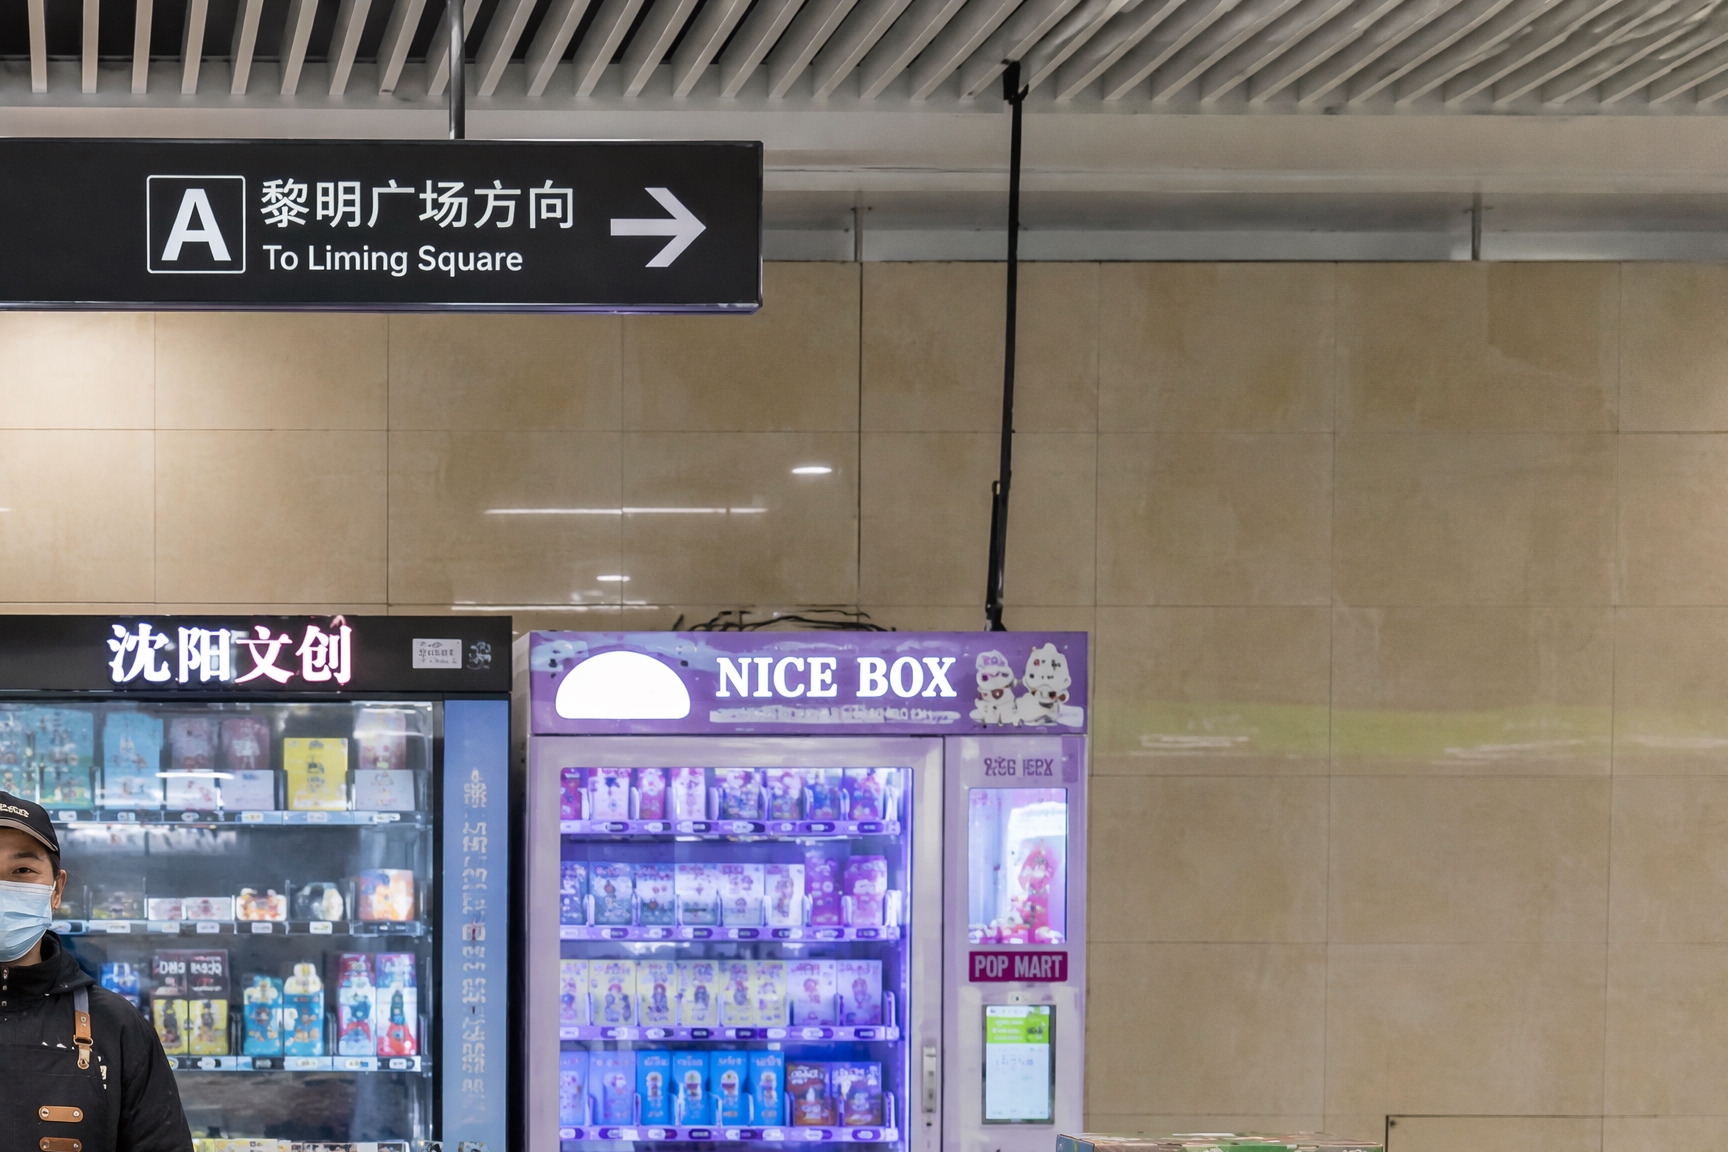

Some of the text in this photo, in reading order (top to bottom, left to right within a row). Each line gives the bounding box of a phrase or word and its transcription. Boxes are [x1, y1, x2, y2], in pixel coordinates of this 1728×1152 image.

[161, 188, 232, 262] A
[260, 177, 574, 229] 黎明广场方向
[262, 244, 523, 278] To Liming Square
[106, 622, 353, 685] 沈阳文创
[715, 656, 957, 698] NICE BOX
[974, 955, 1063, 978] POP MART
